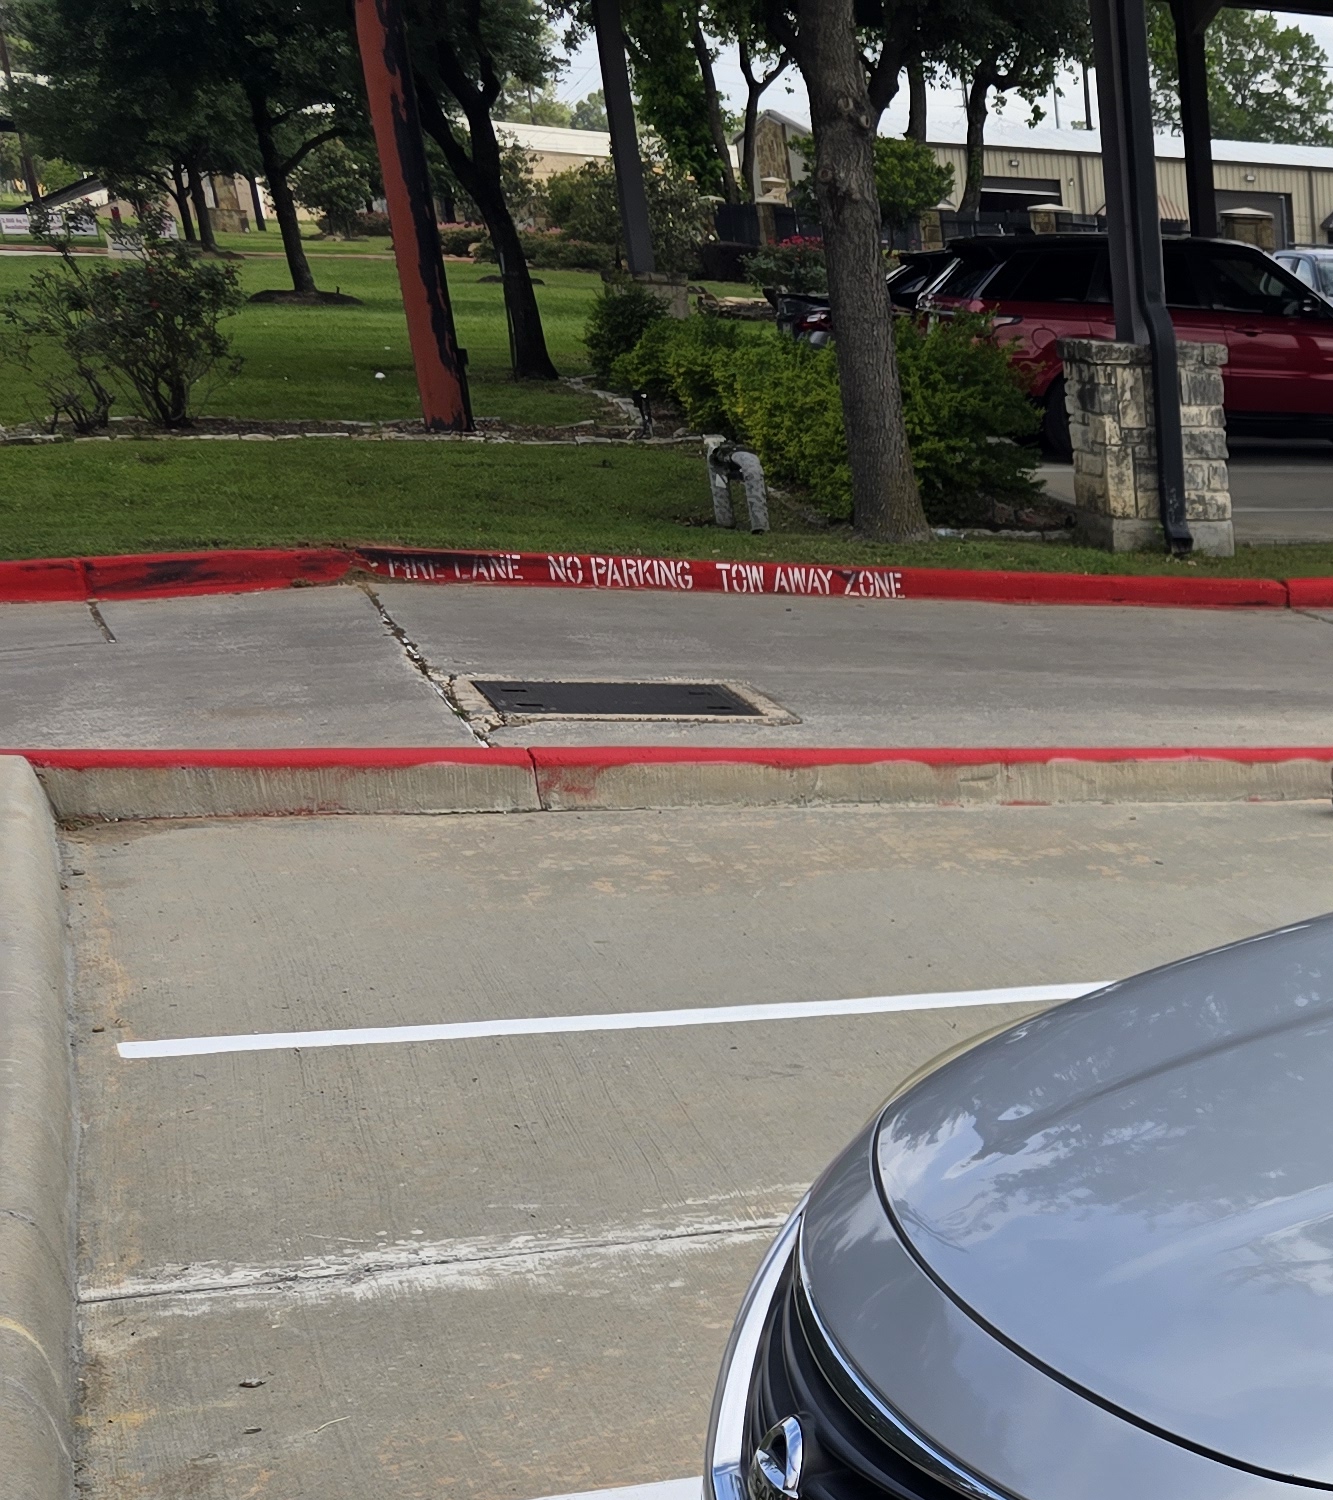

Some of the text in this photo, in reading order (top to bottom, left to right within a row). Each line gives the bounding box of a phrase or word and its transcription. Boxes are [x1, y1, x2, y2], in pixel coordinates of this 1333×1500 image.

[454, 554, 523, 581] LANE
[548, 555, 583, 584] NO
[591, 557, 693, 589] PARKING
[716, 562, 764, 593] TOW
[774, 565, 833, 595] AWAY
[841, 569, 905, 599] ZONE
